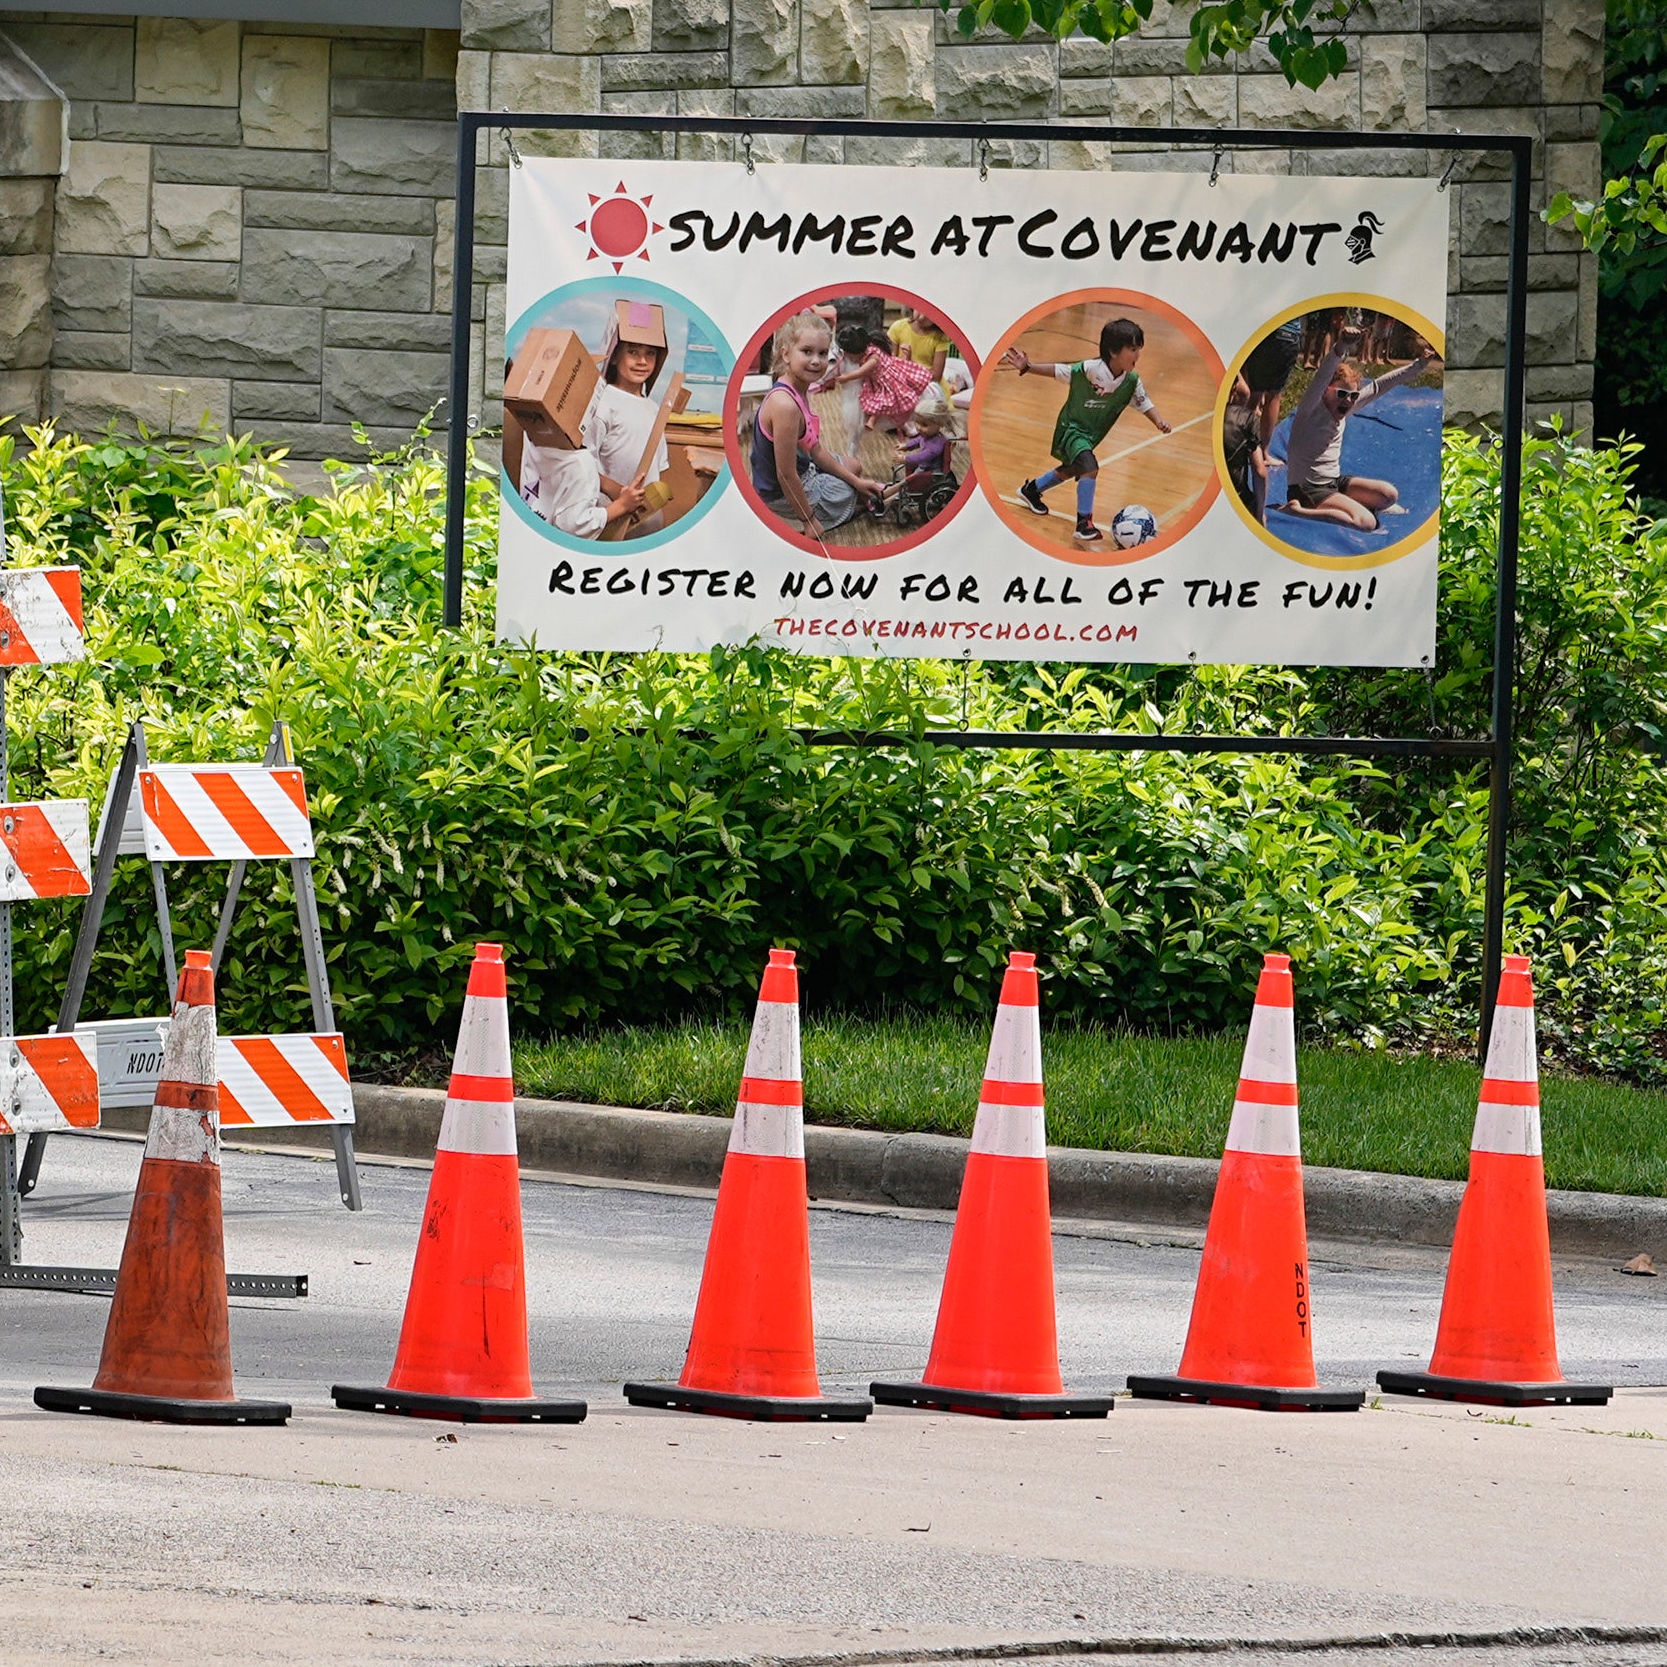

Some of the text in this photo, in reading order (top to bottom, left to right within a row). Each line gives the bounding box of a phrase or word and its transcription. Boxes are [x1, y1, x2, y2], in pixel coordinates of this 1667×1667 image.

[668, 209, 1344, 266] SUMMER AT COVENANT
[548, 560, 1378, 610] REGISTER NOW FOR ALL OF THE FUN!
[774, 617, 1138, 643] THECOVENANTSCHOOL.COM
[1295, 1263, 1307, 1338] NDOT
